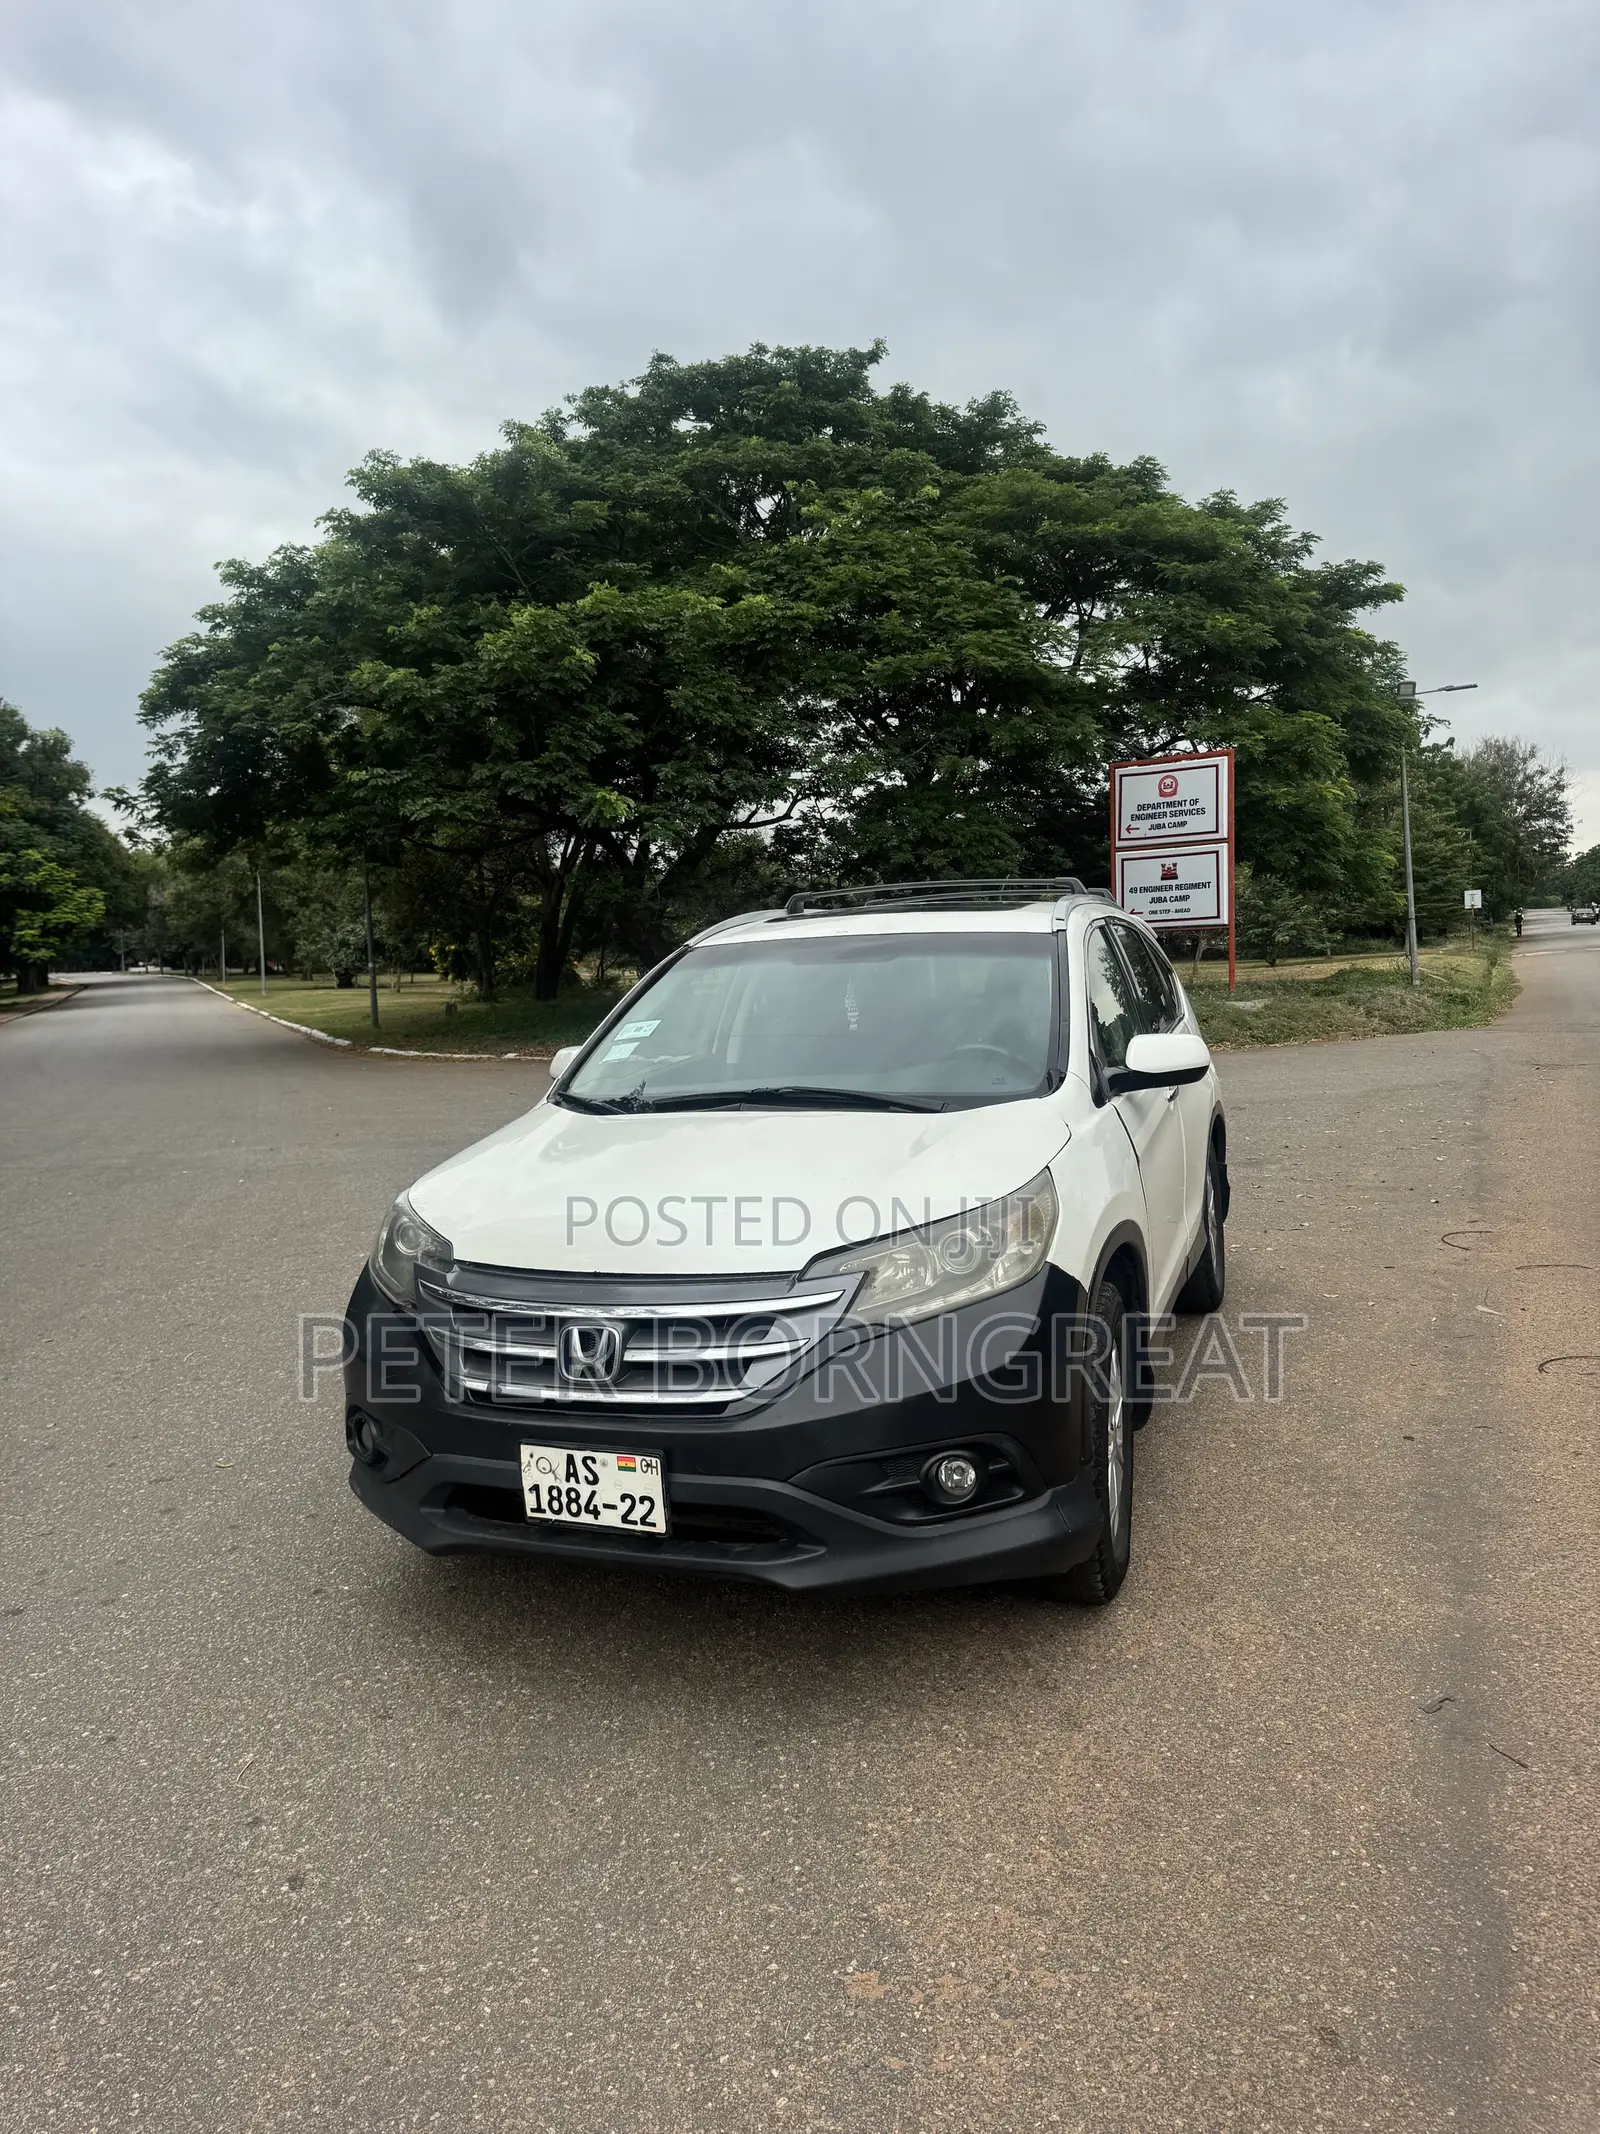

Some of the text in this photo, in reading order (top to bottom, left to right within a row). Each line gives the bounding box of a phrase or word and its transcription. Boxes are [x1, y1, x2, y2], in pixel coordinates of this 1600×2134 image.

[1137, 798, 1200, 811] DEPARTMENT OF
[1130, 807, 1206, 822] ENGINEER SERVICES
[1148, 820, 1188, 831] JUBA CAMP
[1128, 882, 1212, 894] 49 ENGINEER REGIMENT
[1148, 895, 1190, 904] JUBA CAMP
[1148, 908, 1159, 916] ONE
[565, 1453, 599, 1486] AS
[528, 1483, 657, 1528] 1884-22
